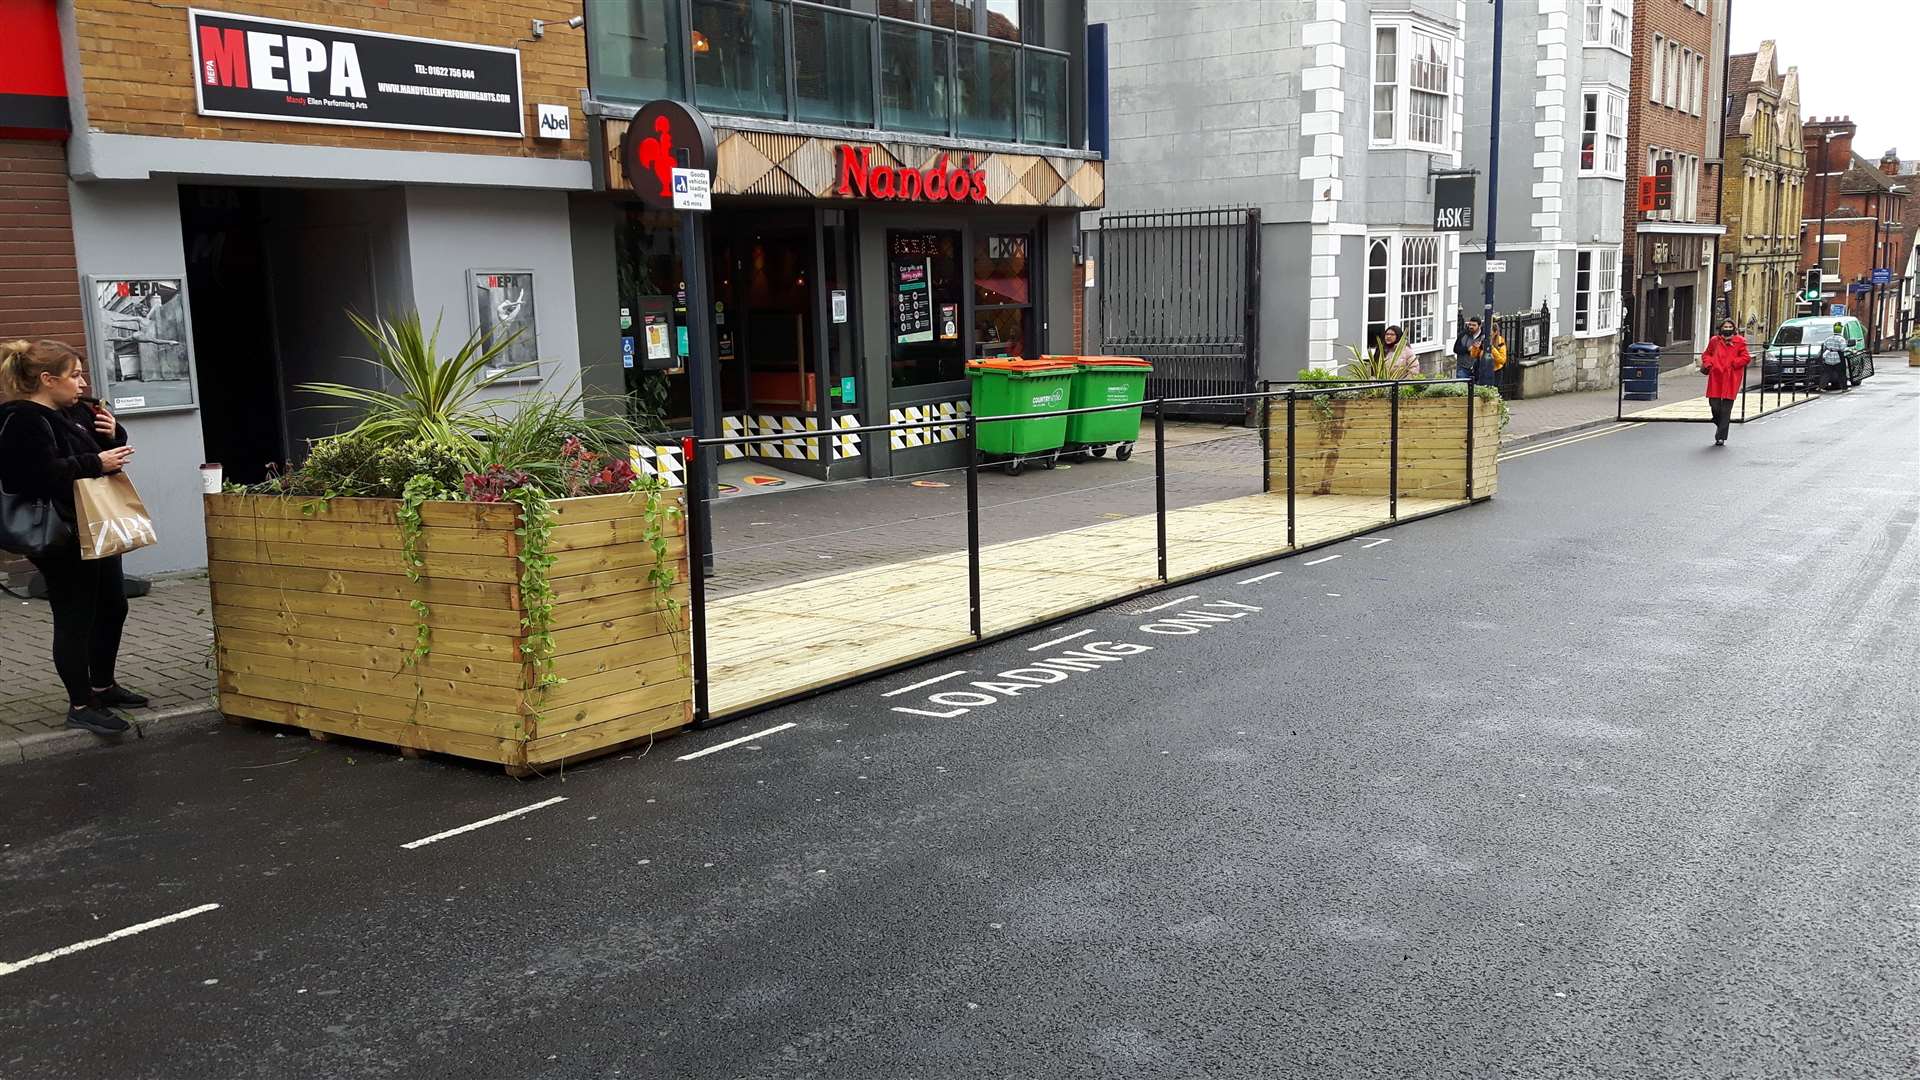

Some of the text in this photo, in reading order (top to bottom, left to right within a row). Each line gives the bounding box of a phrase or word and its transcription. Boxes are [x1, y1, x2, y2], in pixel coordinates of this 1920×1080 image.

[200, 26, 367, 99] MEPA
[206, 60, 216, 83] MEPA
[414, 64, 427, 74] TEL:
[427, 66, 448, 77] 01622
[462, 69, 475, 79] 644
[378, 82, 510, 103] WWW.MANDYELLENPERFORMINGARTS.COM
[287, 96, 368, 109] Mandy Ellen Performing Arts
[541, 113, 568, 130] Abel
[834, 144, 987, 200] Nando's
[689, 185, 708, 193] loading
[1437, 207, 1462, 228] ASK
[117, 281, 161, 297] MEPA
[488, 275, 519, 288] MEPA
[890, 599, 1263, 718] LOADING ONLY
